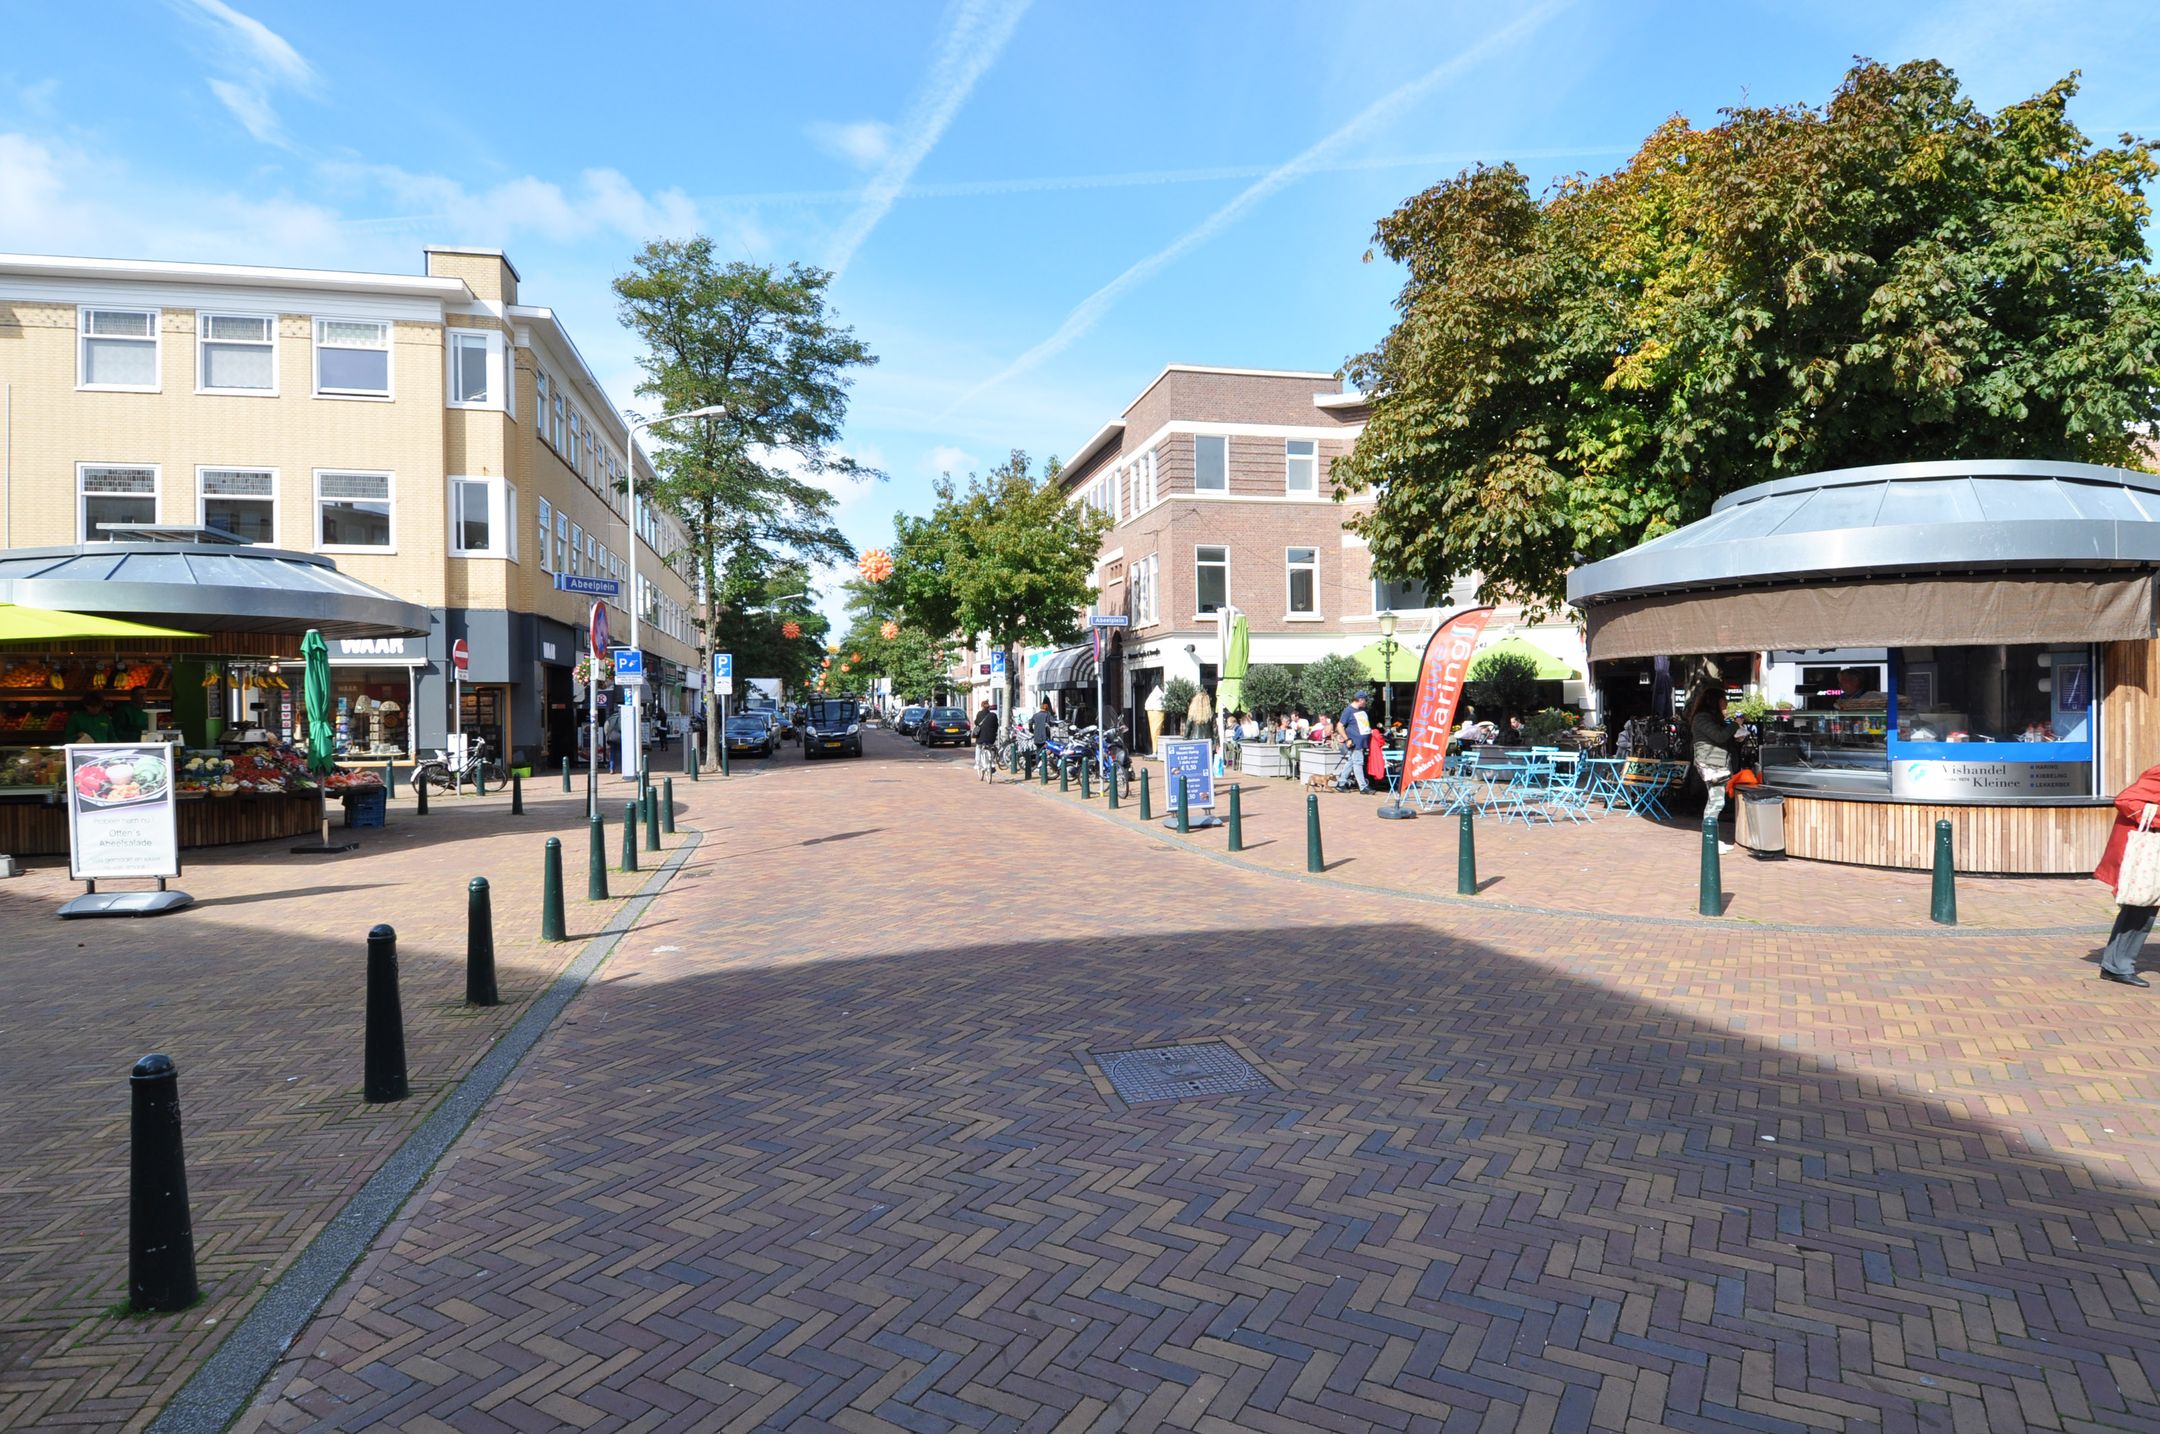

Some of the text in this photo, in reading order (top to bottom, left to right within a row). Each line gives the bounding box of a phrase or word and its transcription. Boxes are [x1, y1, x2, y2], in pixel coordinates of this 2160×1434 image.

[570, 579, 616, 592] Abeelplein
[340, 638, 404, 654] WAAR
[1411, 643, 1447, 747] Nieuwe
[1423, 639, 1472, 750] Haring
[1942, 764, 2006, 776] Vishandel
[1973, 777, 2020, 788] Kleinee
